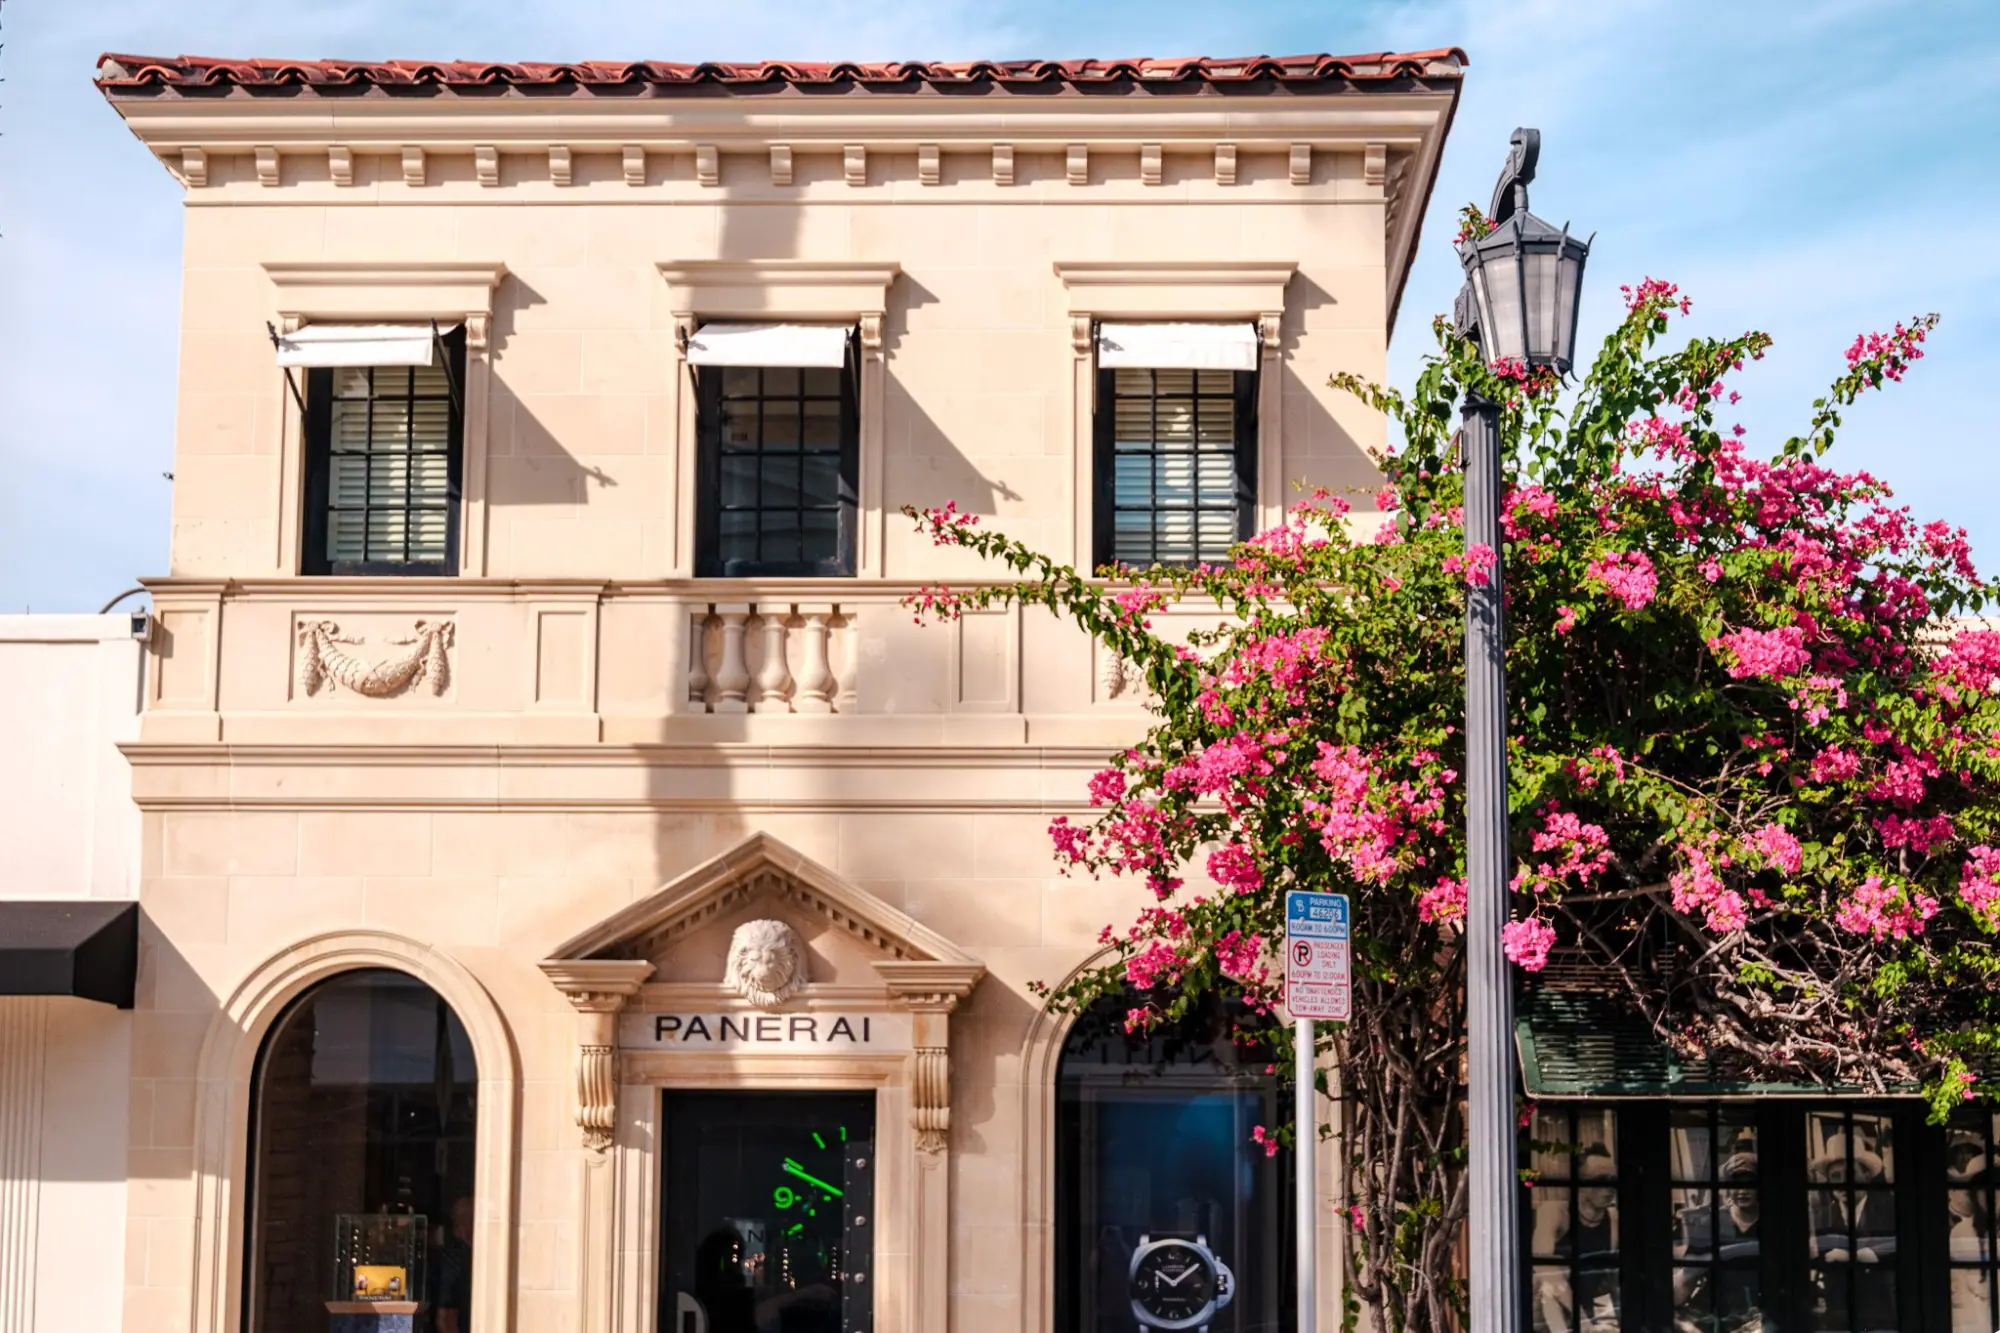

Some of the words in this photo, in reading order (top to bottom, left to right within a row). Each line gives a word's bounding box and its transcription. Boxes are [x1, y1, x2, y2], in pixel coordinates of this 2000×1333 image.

[1310, 897, 1341, 907] PARKING
[1313, 908, 1340, 918] 46206
[1314, 924, 1322, 932] TO
[1313, 941, 1344, 950] PASSENGER
[1318, 951, 1340, 959] LOADING
[1321, 960, 1336, 968] ONLY
[1313, 971, 1321, 979] TO
[1292, 995, 1318, 1003] VEHICLES
[1295, 1003, 1324, 1012] TOW-AWAY
[1328, 1005, 1342, 1013] ZONE
[655, 1016, 870, 1042] PANERAI
